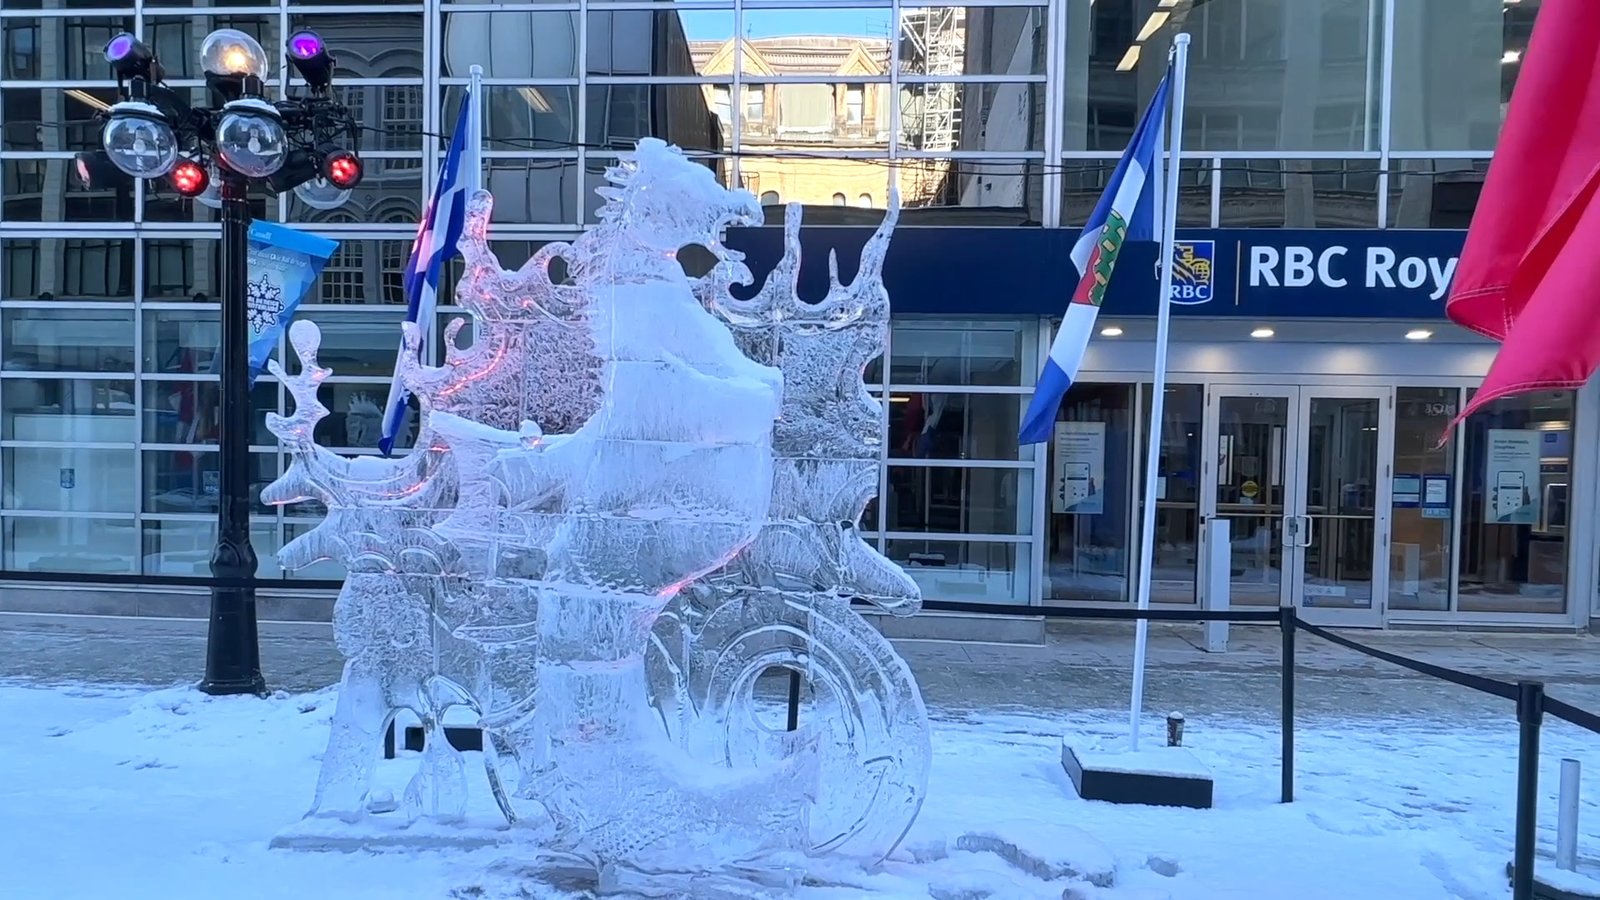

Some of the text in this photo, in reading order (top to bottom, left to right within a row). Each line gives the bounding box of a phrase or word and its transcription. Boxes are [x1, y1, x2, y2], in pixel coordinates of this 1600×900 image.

[1250, 246, 1458, 300] RBC Roy
[1170, 285, 1208, 298] RBC
